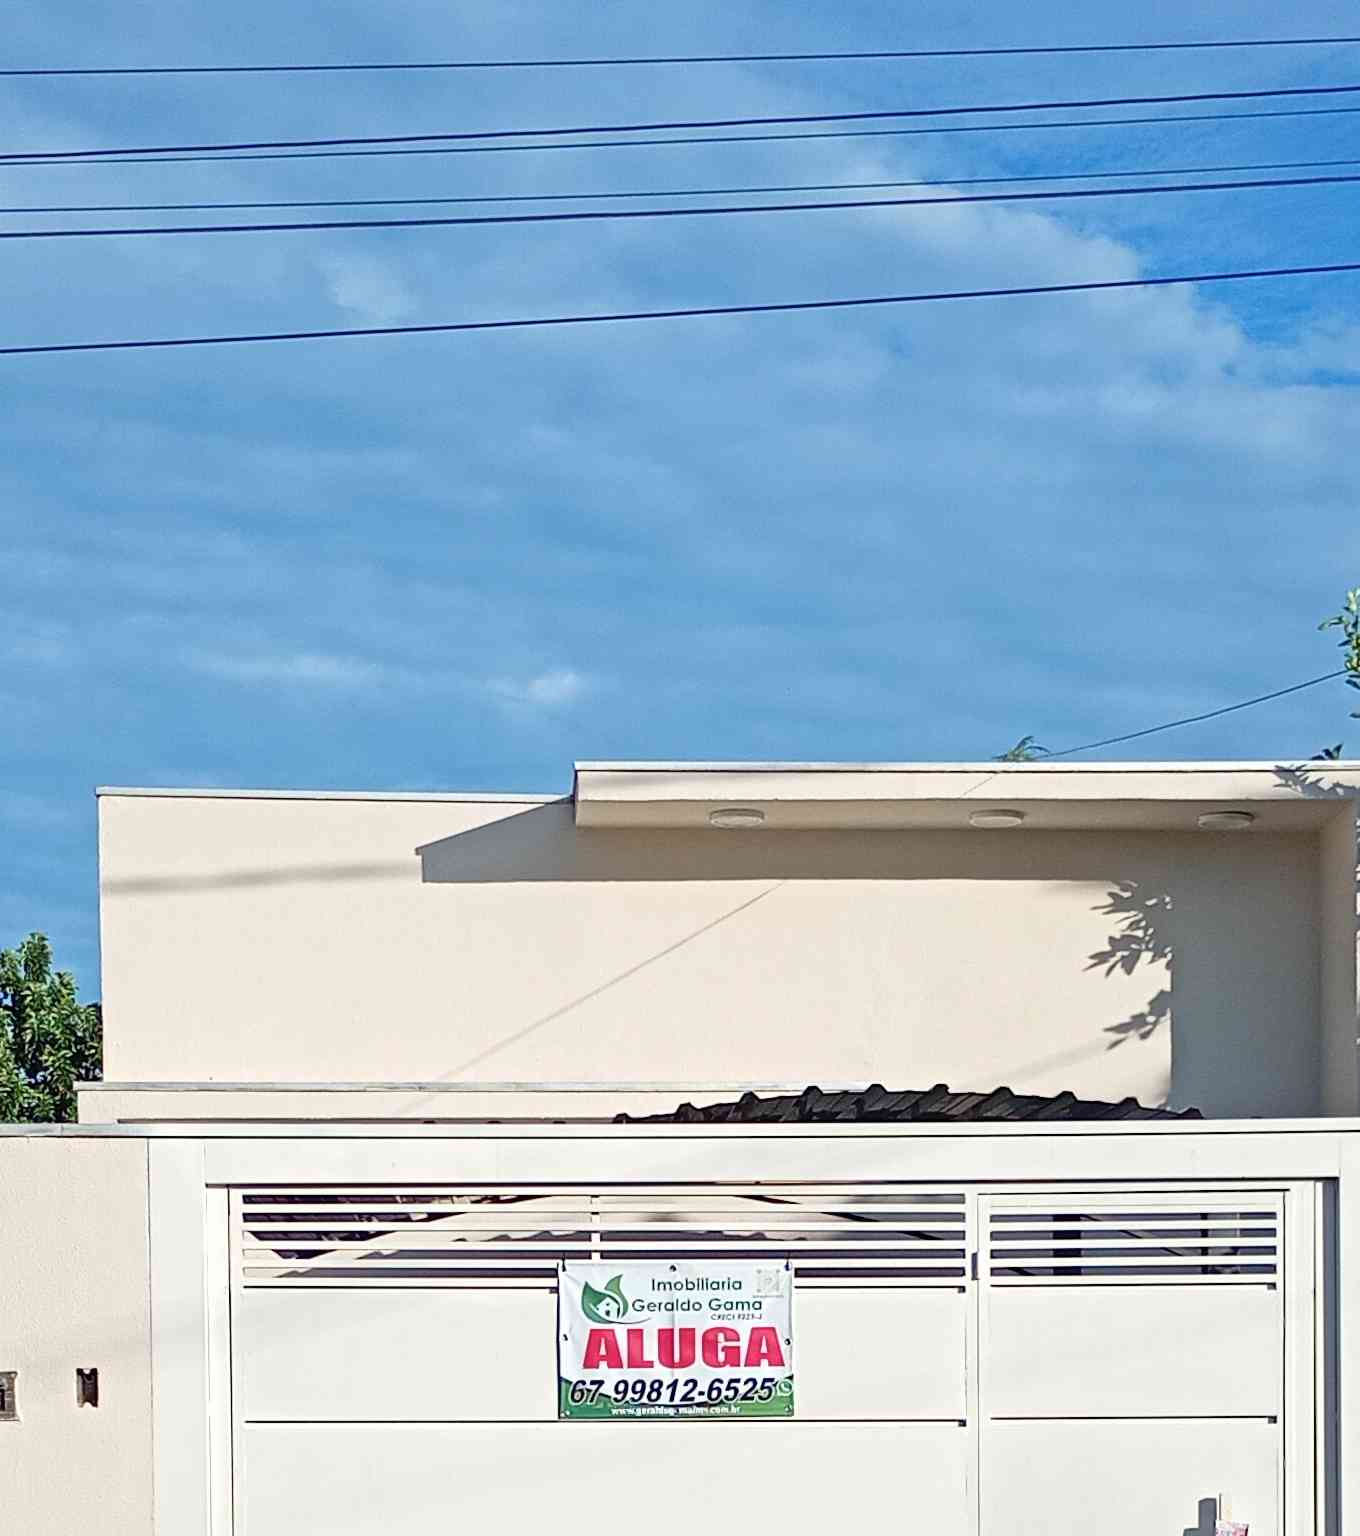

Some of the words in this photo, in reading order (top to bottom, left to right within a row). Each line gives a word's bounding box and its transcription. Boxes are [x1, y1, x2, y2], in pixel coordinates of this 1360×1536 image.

[651, 1278, 743, 1292] Imobiliaria
[631, 1298, 703, 1312] Geraldo
[708, 1298, 762, 1311] Gama
[582, 1327, 785, 1369] ALUGA
[570, 1379, 605, 1404] 67
[612, 1377, 776, 1404] 99812-6525
